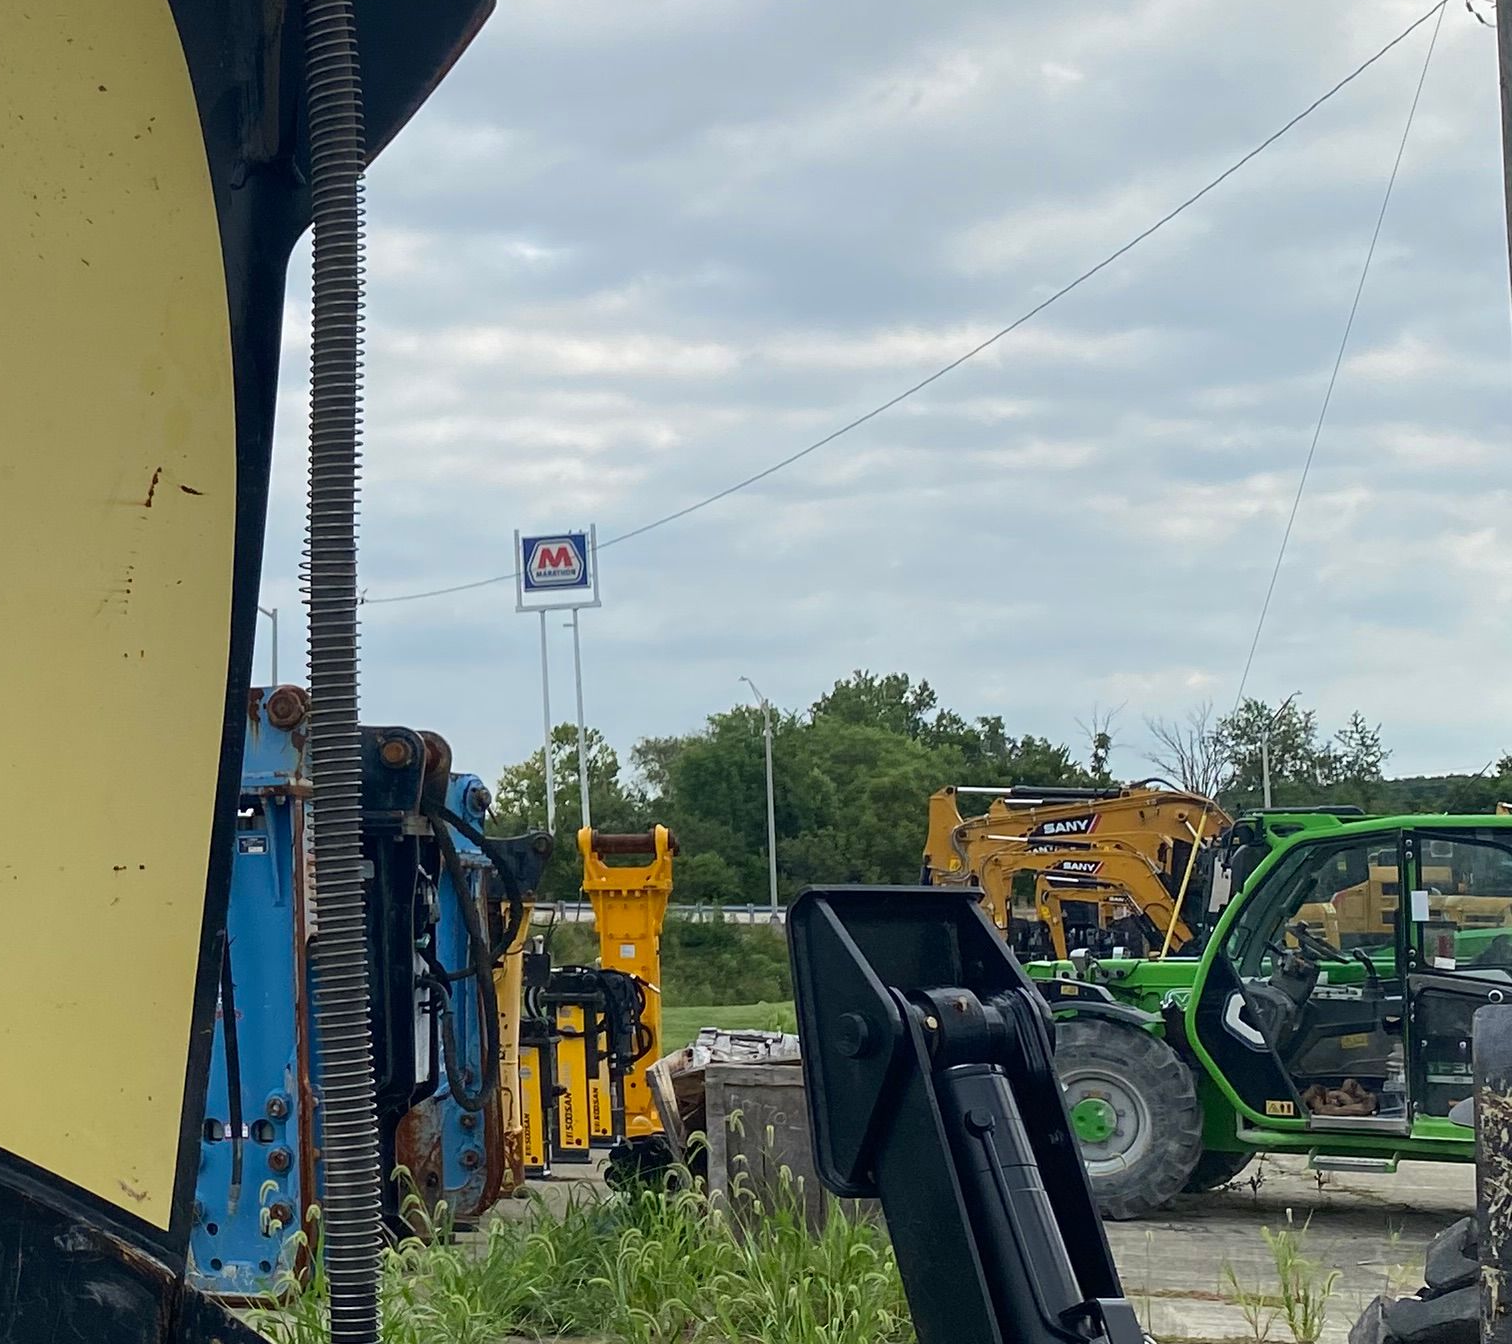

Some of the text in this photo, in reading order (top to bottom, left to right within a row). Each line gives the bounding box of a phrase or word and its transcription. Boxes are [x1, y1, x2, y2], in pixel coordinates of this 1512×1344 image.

[538, 547, 573, 568] M
[1043, 819, 1089, 834] SANY
[1063, 862, 1095, 871] SANY
[565, 1093, 573, 1131] SOOSAN
